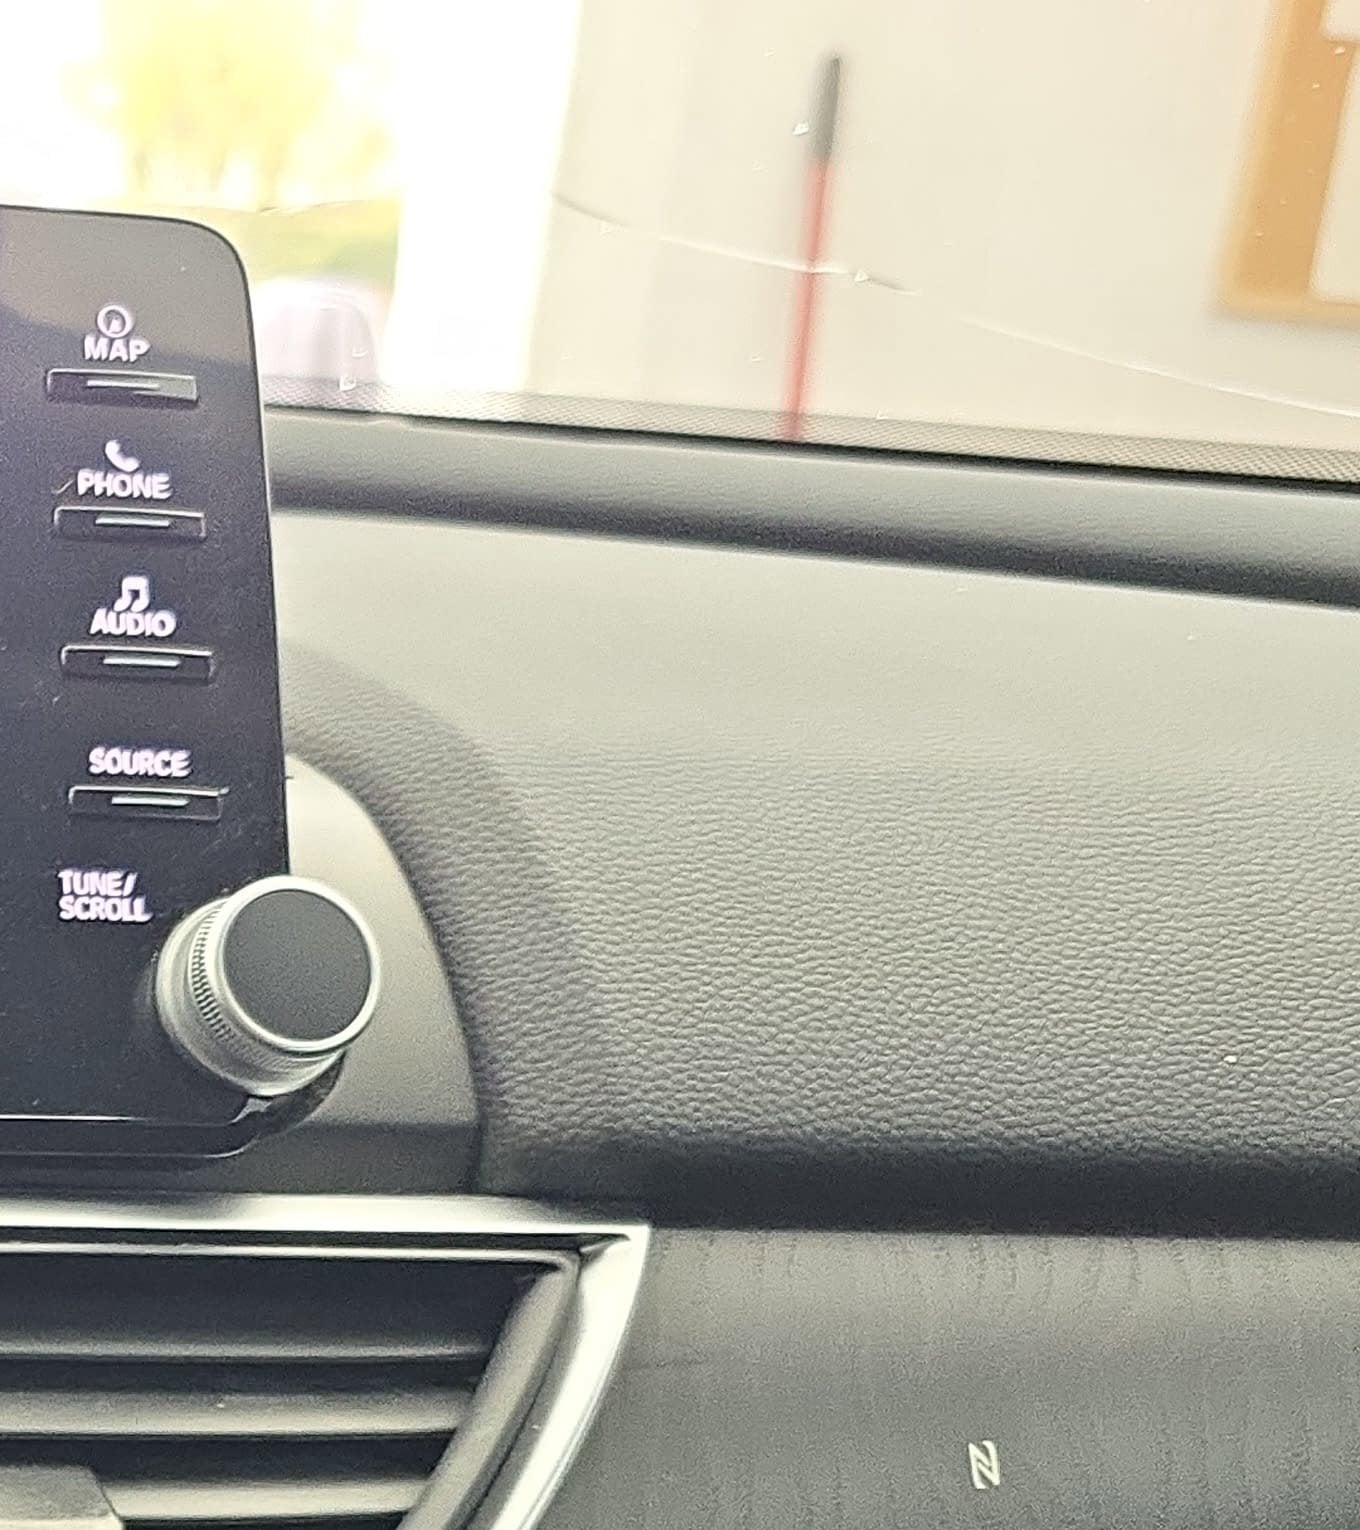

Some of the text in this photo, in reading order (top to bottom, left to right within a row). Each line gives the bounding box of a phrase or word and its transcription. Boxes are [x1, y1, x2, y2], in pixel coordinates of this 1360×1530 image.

[83, 334, 151, 362] MAP
[77, 468, 173, 500] PHONE
[89, 608, 178, 638] AUDIO
[88, 747, 192, 778] SOURCE
[57, 869, 138, 897] TUNE/
[58, 896, 153, 923] SCROLL
